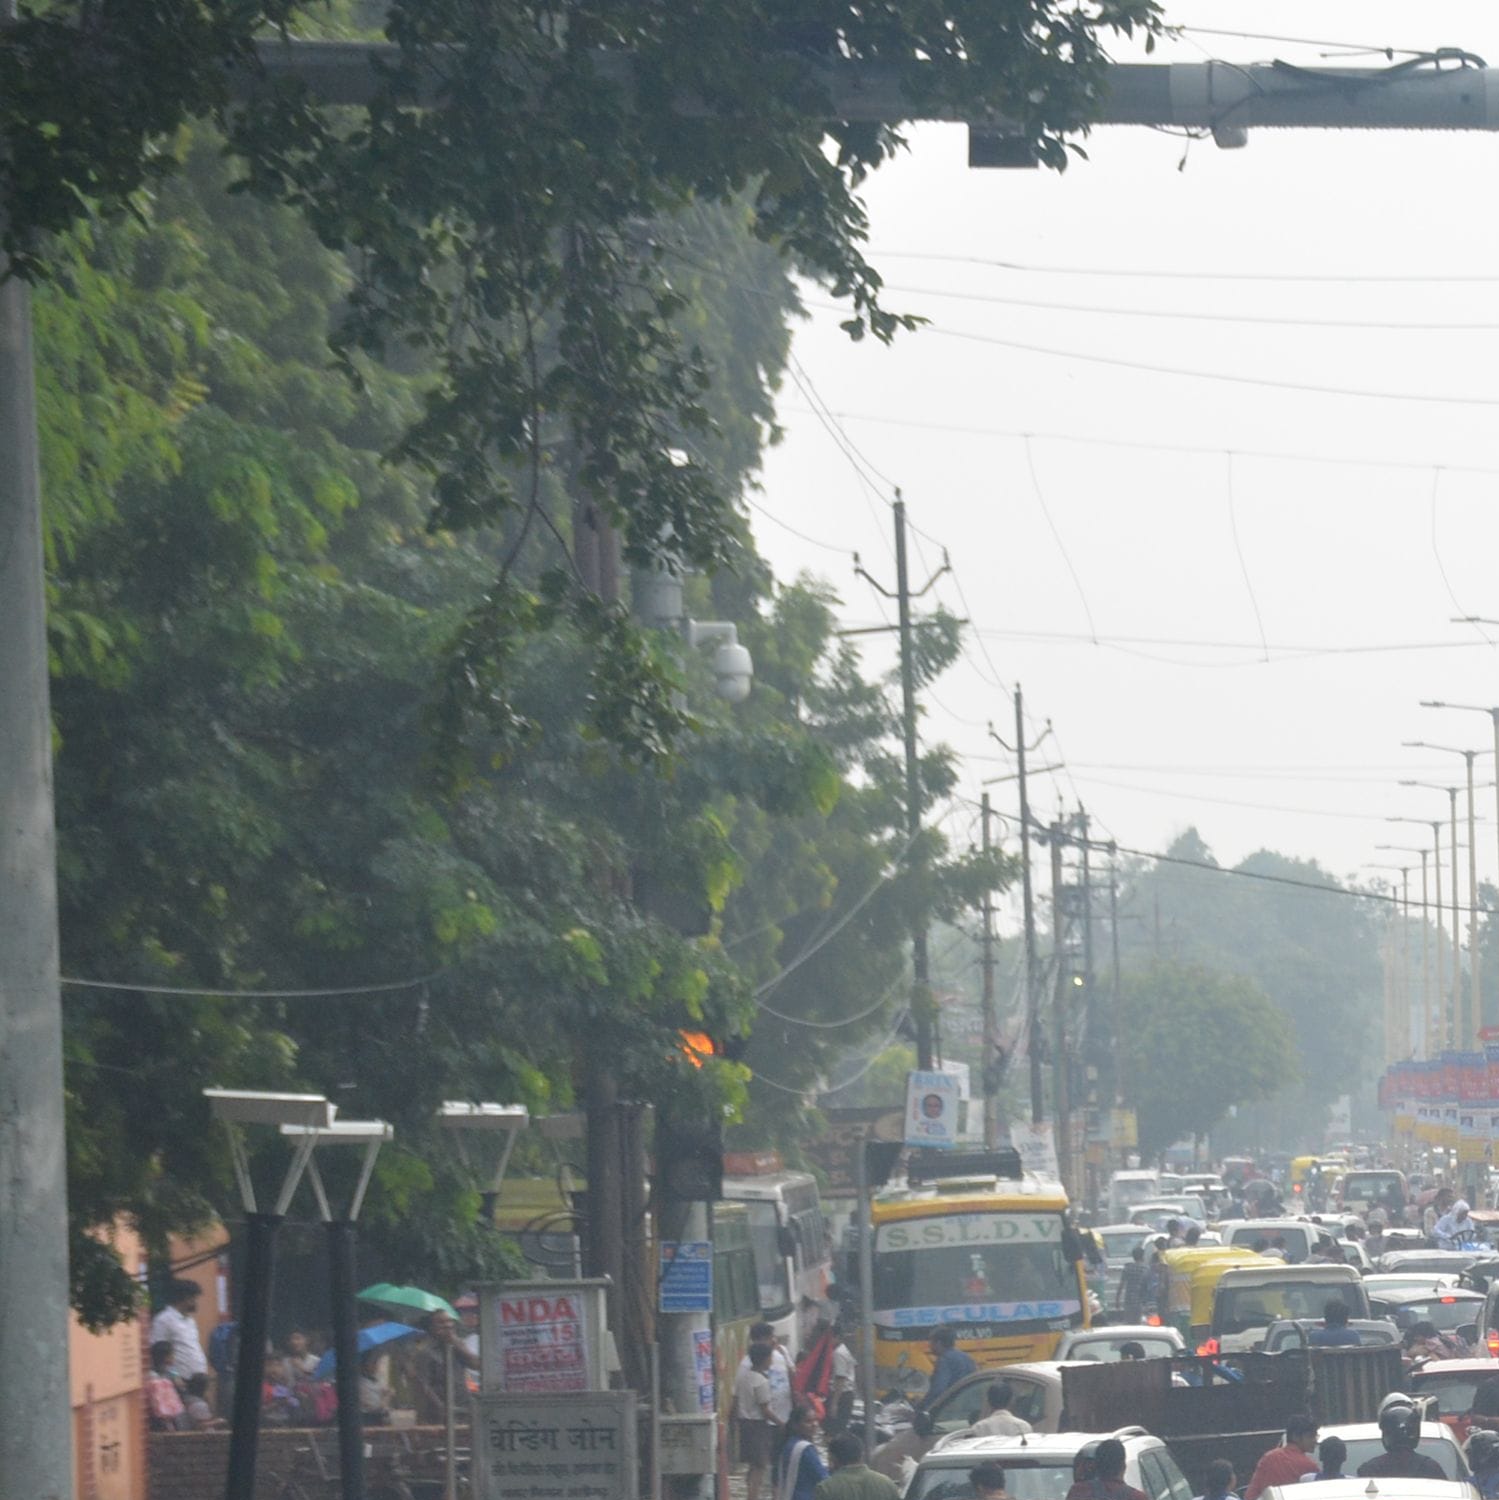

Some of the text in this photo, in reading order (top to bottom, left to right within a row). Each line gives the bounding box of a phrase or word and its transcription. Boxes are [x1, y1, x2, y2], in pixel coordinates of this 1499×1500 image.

[501, 1297, 577, 1324] NDA
[894, 1301, 1065, 1326] SECULAR
[550, 1325, 575, 1342] 15
